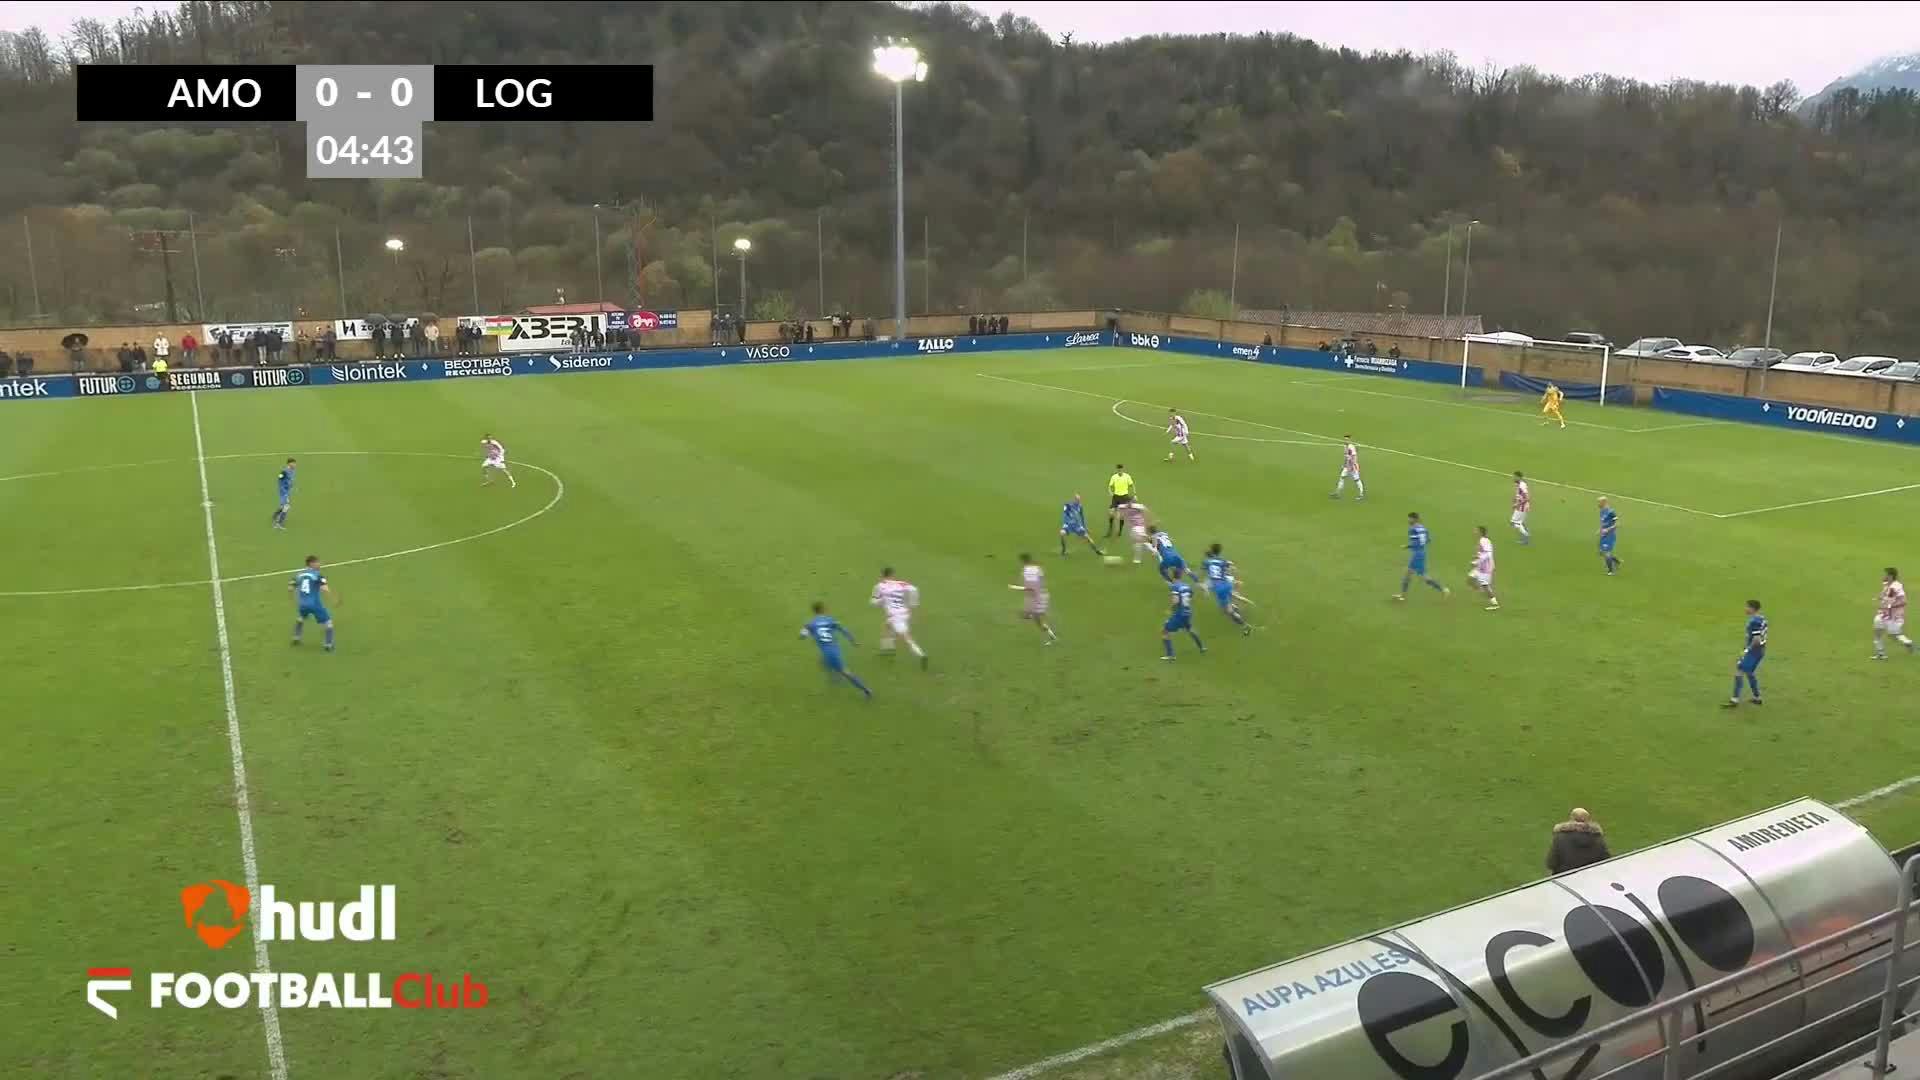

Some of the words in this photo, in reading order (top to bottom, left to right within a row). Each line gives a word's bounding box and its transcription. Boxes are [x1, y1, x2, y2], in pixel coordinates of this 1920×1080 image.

[918, 339, 954, 350] ZALLO
[1131, 333, 1150, 347] bbk
[745, 346, 790, 359] VASCO
[445, 357, 510, 370] BEOTIBAR
[562, 356, 613, 369] sidenor
[170, 372, 221, 386] SEGUNDA
[345, 363, 407, 381] lointek
[445, 368, 501, 376] RECYCLING
[1787, 406, 1877, 430] YOOMEDOO
[1727, 811, 1830, 852] AMOREBIETA
[1241, 981, 1316, 1016] AUPA
[1313, 949, 1411, 993] AZULES
